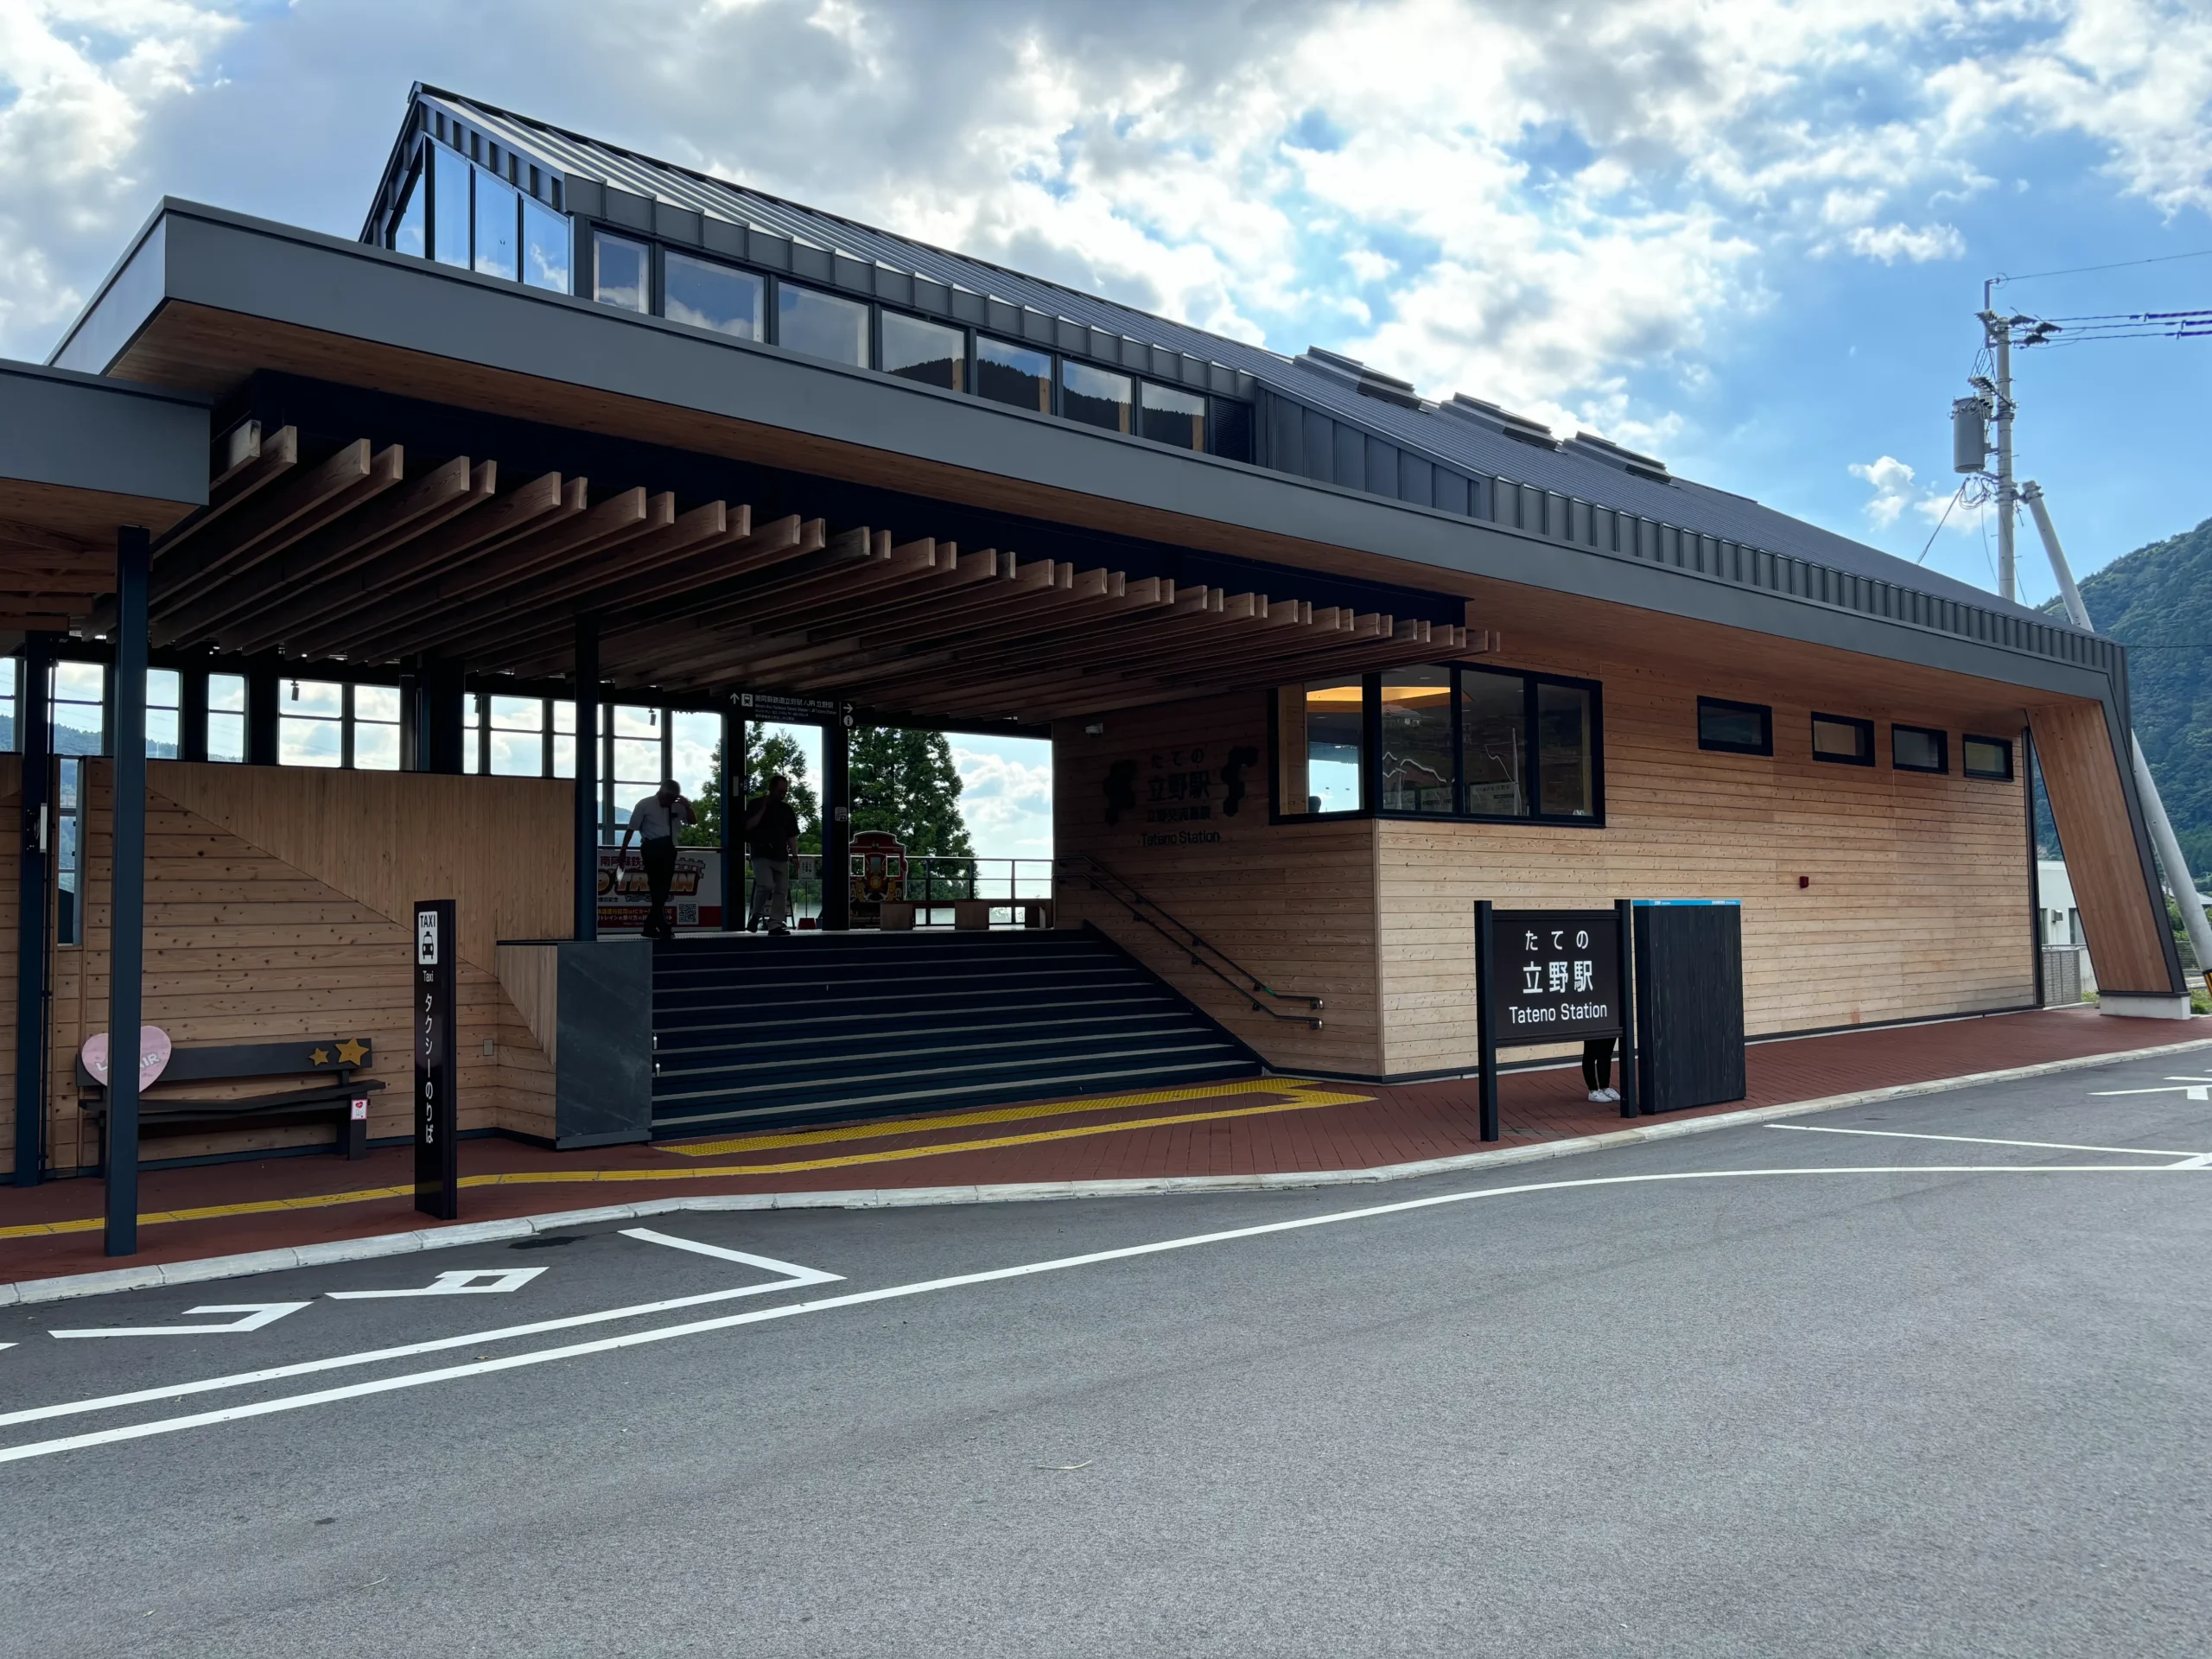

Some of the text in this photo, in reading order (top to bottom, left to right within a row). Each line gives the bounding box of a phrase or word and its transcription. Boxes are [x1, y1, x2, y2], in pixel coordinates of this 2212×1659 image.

[1151, 748, 1205, 768] たての
[1147, 771, 1211, 801] 立野駅
[1141, 830, 1220, 846] Tateno Station
[616, 872, 696, 892] TRIN
[420, 914, 436, 928] TAXI
[1525, 930, 1589, 950] たての
[423, 969, 434, 982] Taxi
[1522, 960, 1593, 994] 立野駅
[1509, 1001, 1607, 1024] Tateno Station
[424, 993, 434, 1144] タクシーのりば
